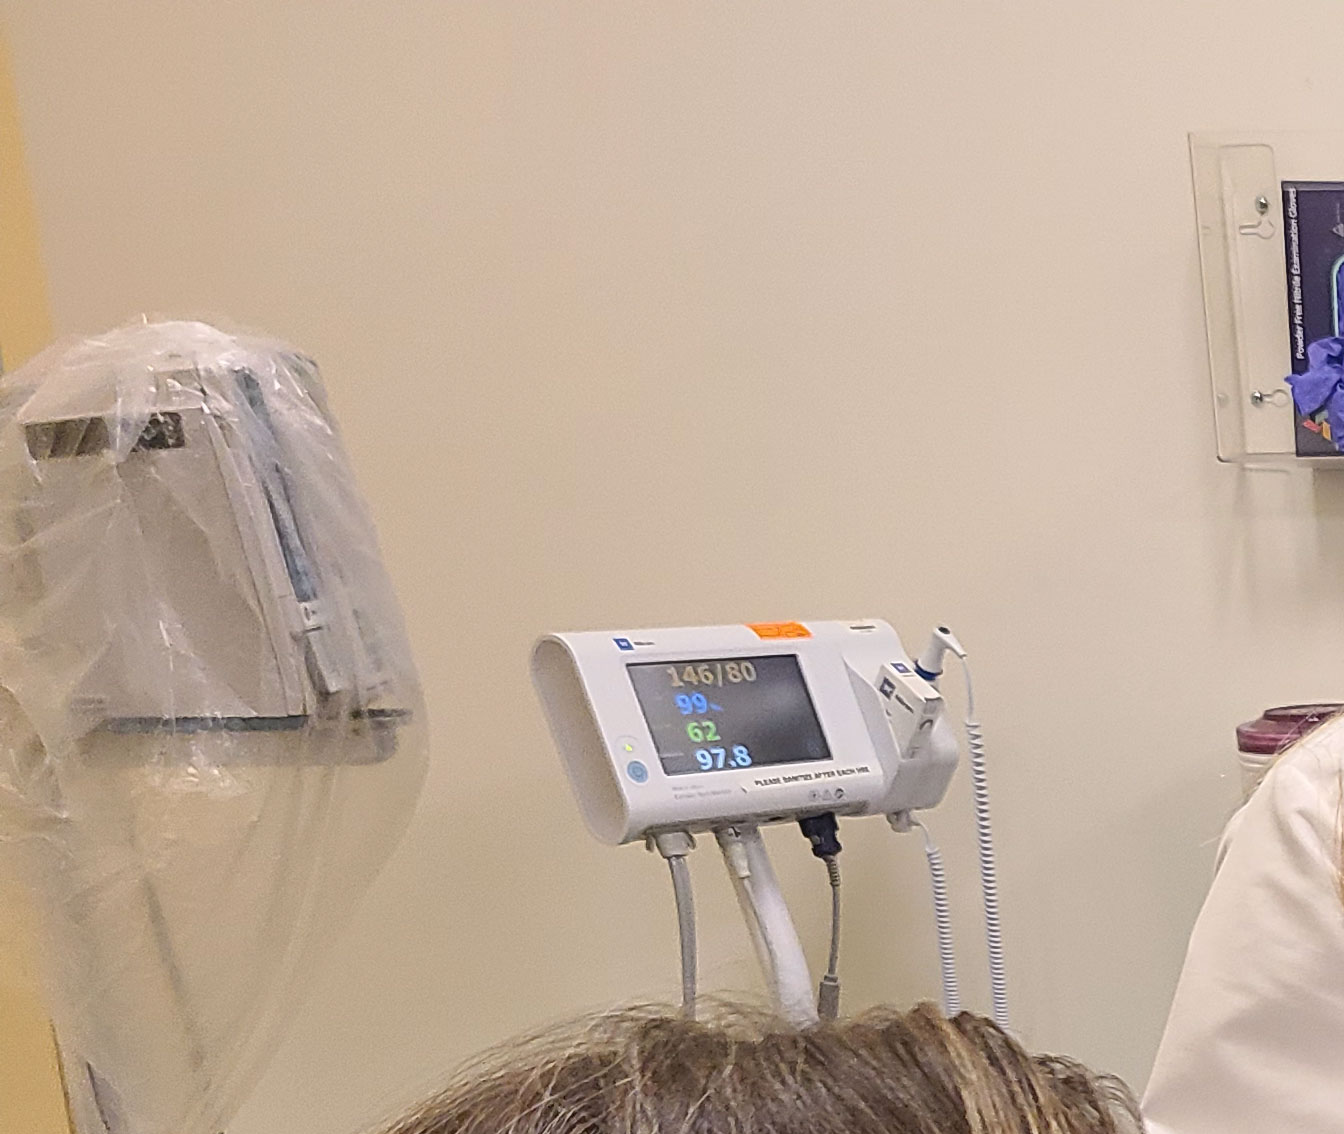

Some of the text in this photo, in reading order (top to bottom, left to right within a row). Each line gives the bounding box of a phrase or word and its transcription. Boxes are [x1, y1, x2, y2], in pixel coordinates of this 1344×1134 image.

[1288, 188, 1305, 359] Powder Free Nitrile Examination Gloves
[667, 661, 757, 687] 146/80
[687, 721, 721, 742] 62
[696, 745, 752, 770] 97.8
